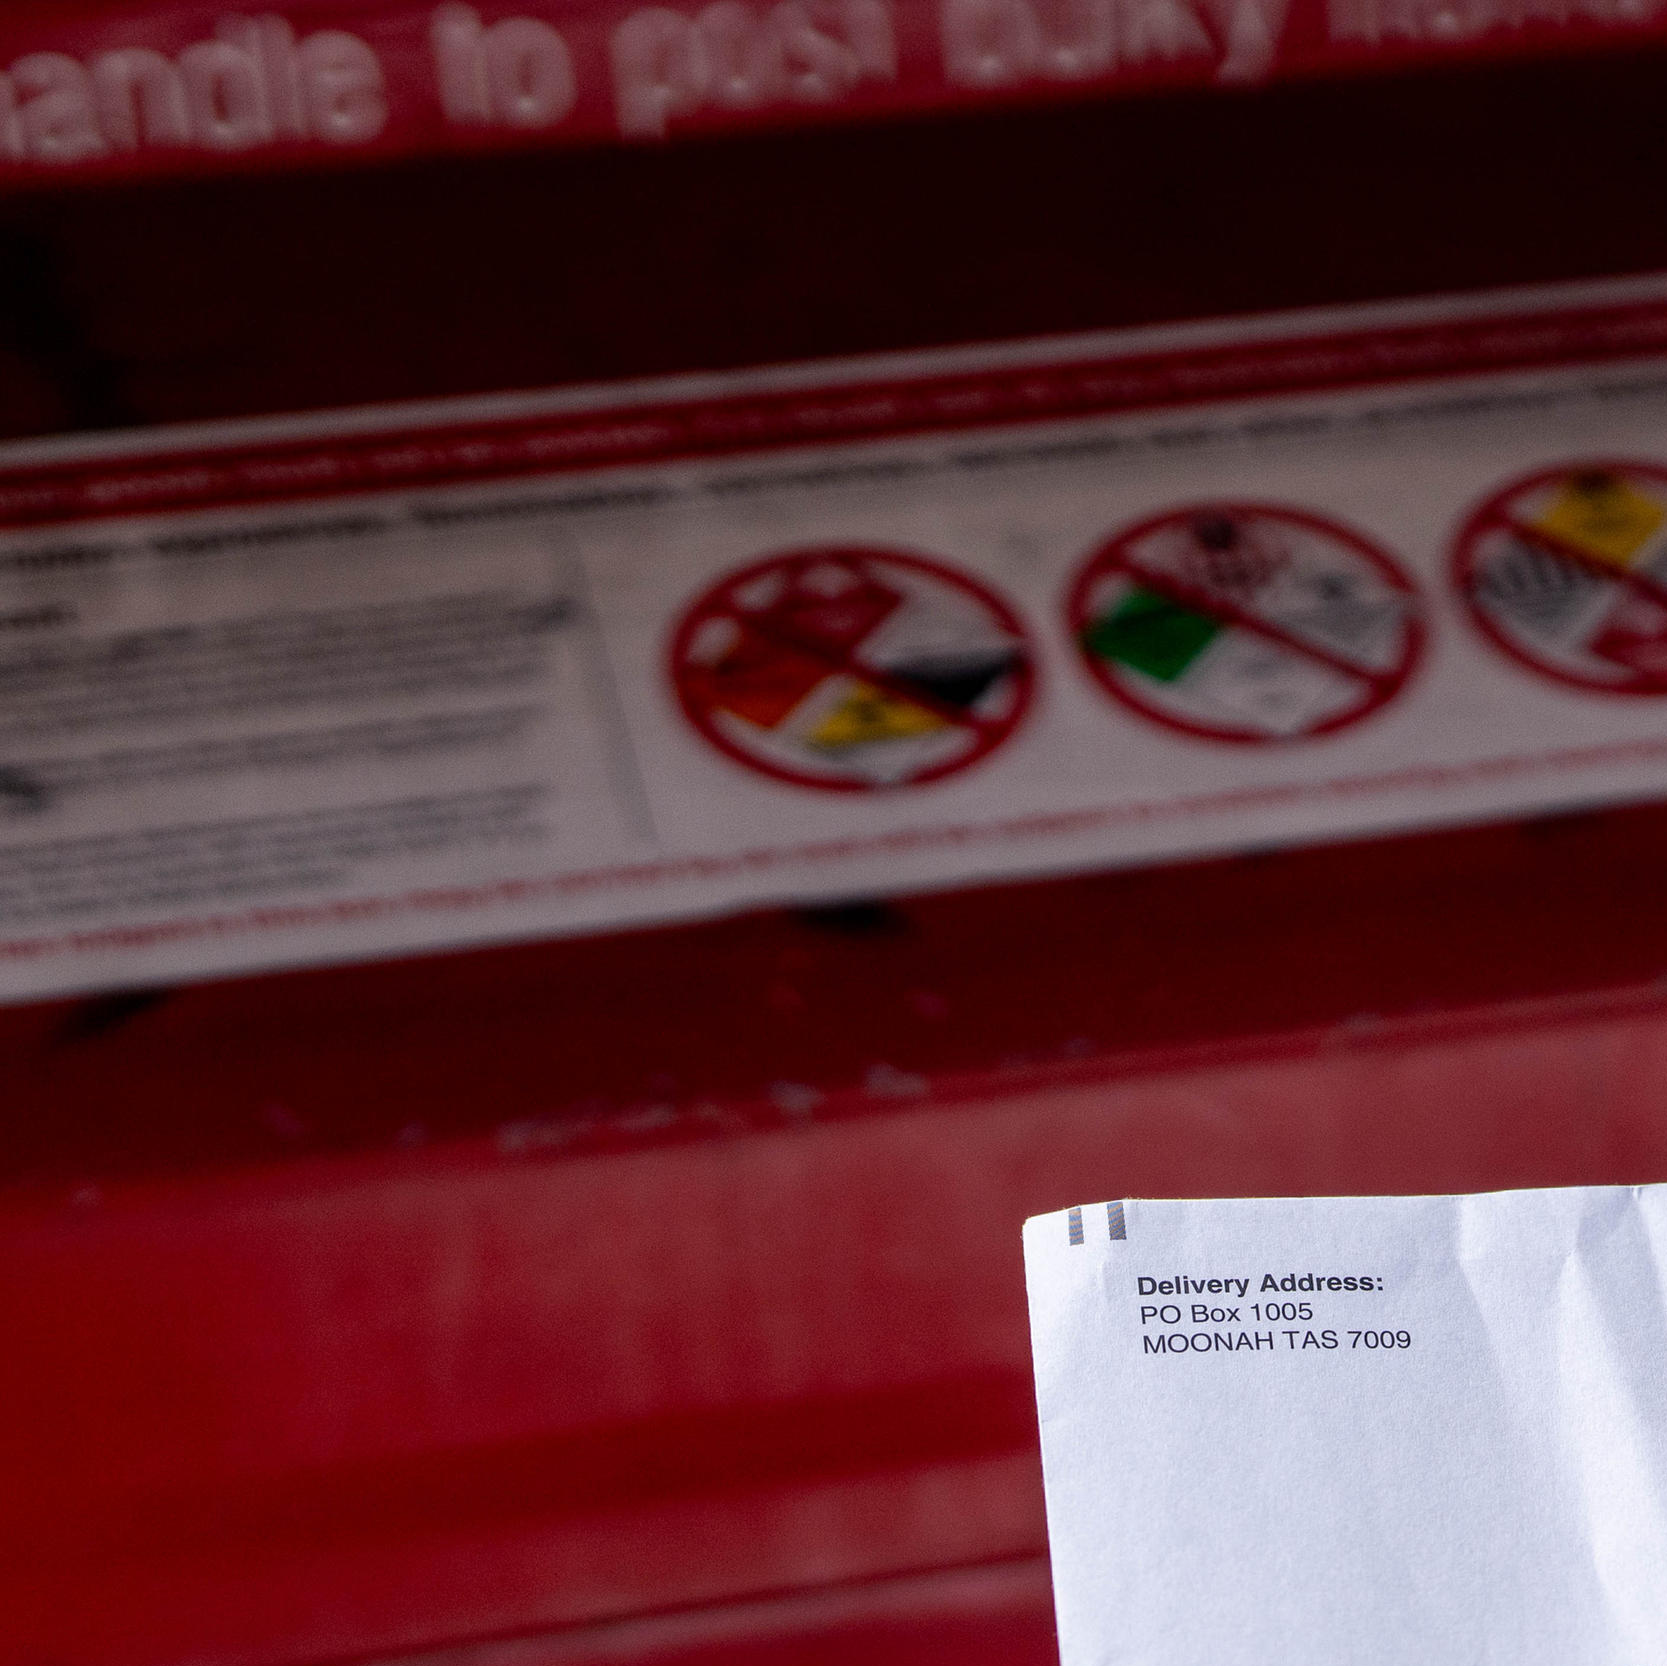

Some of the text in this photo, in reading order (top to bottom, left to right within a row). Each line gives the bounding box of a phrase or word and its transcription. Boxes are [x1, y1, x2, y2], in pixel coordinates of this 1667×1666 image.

[0, 12, 386, 163] andle
[1137, 1272, 1384, 1298] Delivery Address:
[1140, 1302, 1313, 1325] PO Box 1005
[1143, 1329, 1411, 1354] MOONAH TAS 7009
